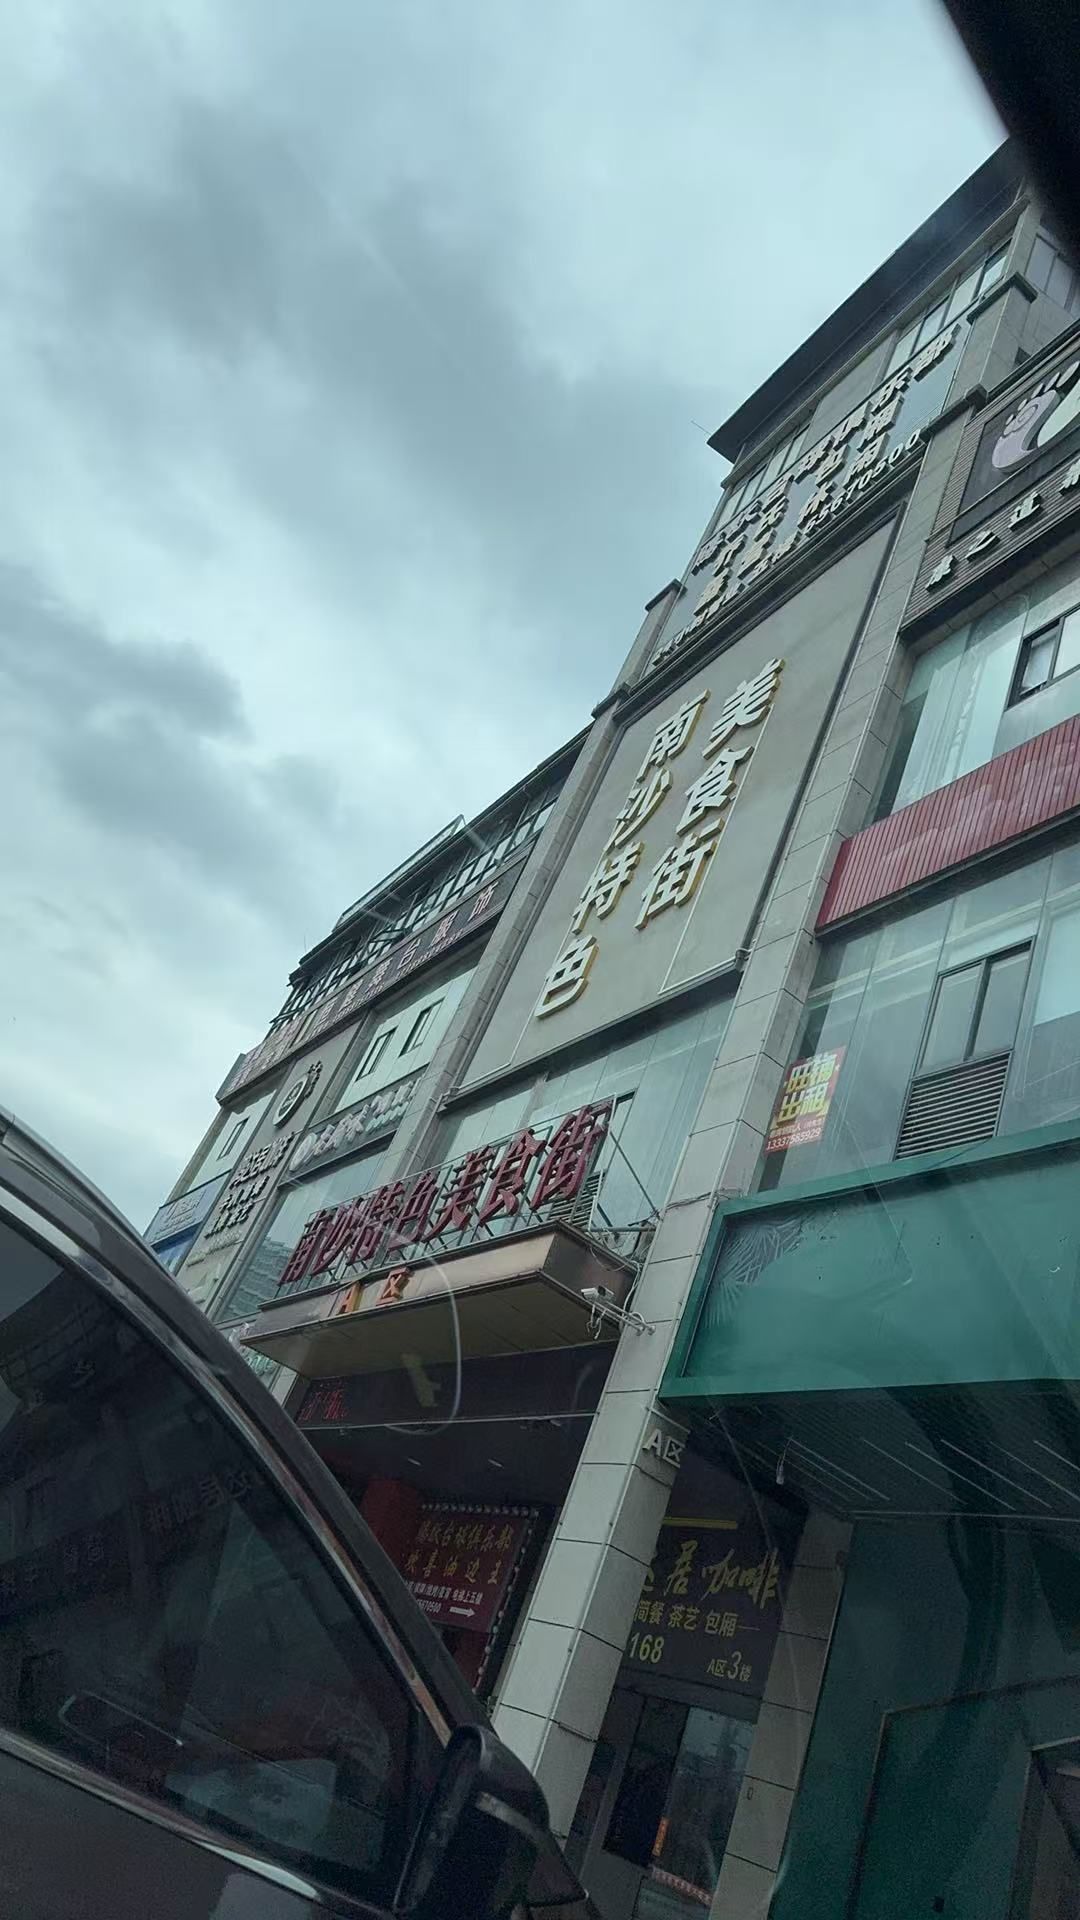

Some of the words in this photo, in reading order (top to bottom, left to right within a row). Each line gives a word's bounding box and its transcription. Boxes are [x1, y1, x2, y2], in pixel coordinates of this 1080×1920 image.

[634, 657, 785, 931] 美食街
[535, 689, 711, 1018] 南沙特色
[279, 1098, 614, 1287] 南沙特色美食街
[643, 1427, 687, 1469] A区
[629, 1632, 665, 1664] 168
[668, 1604, 701, 1632] 茶艺
[704, 1611, 738, 1638] 包厢
